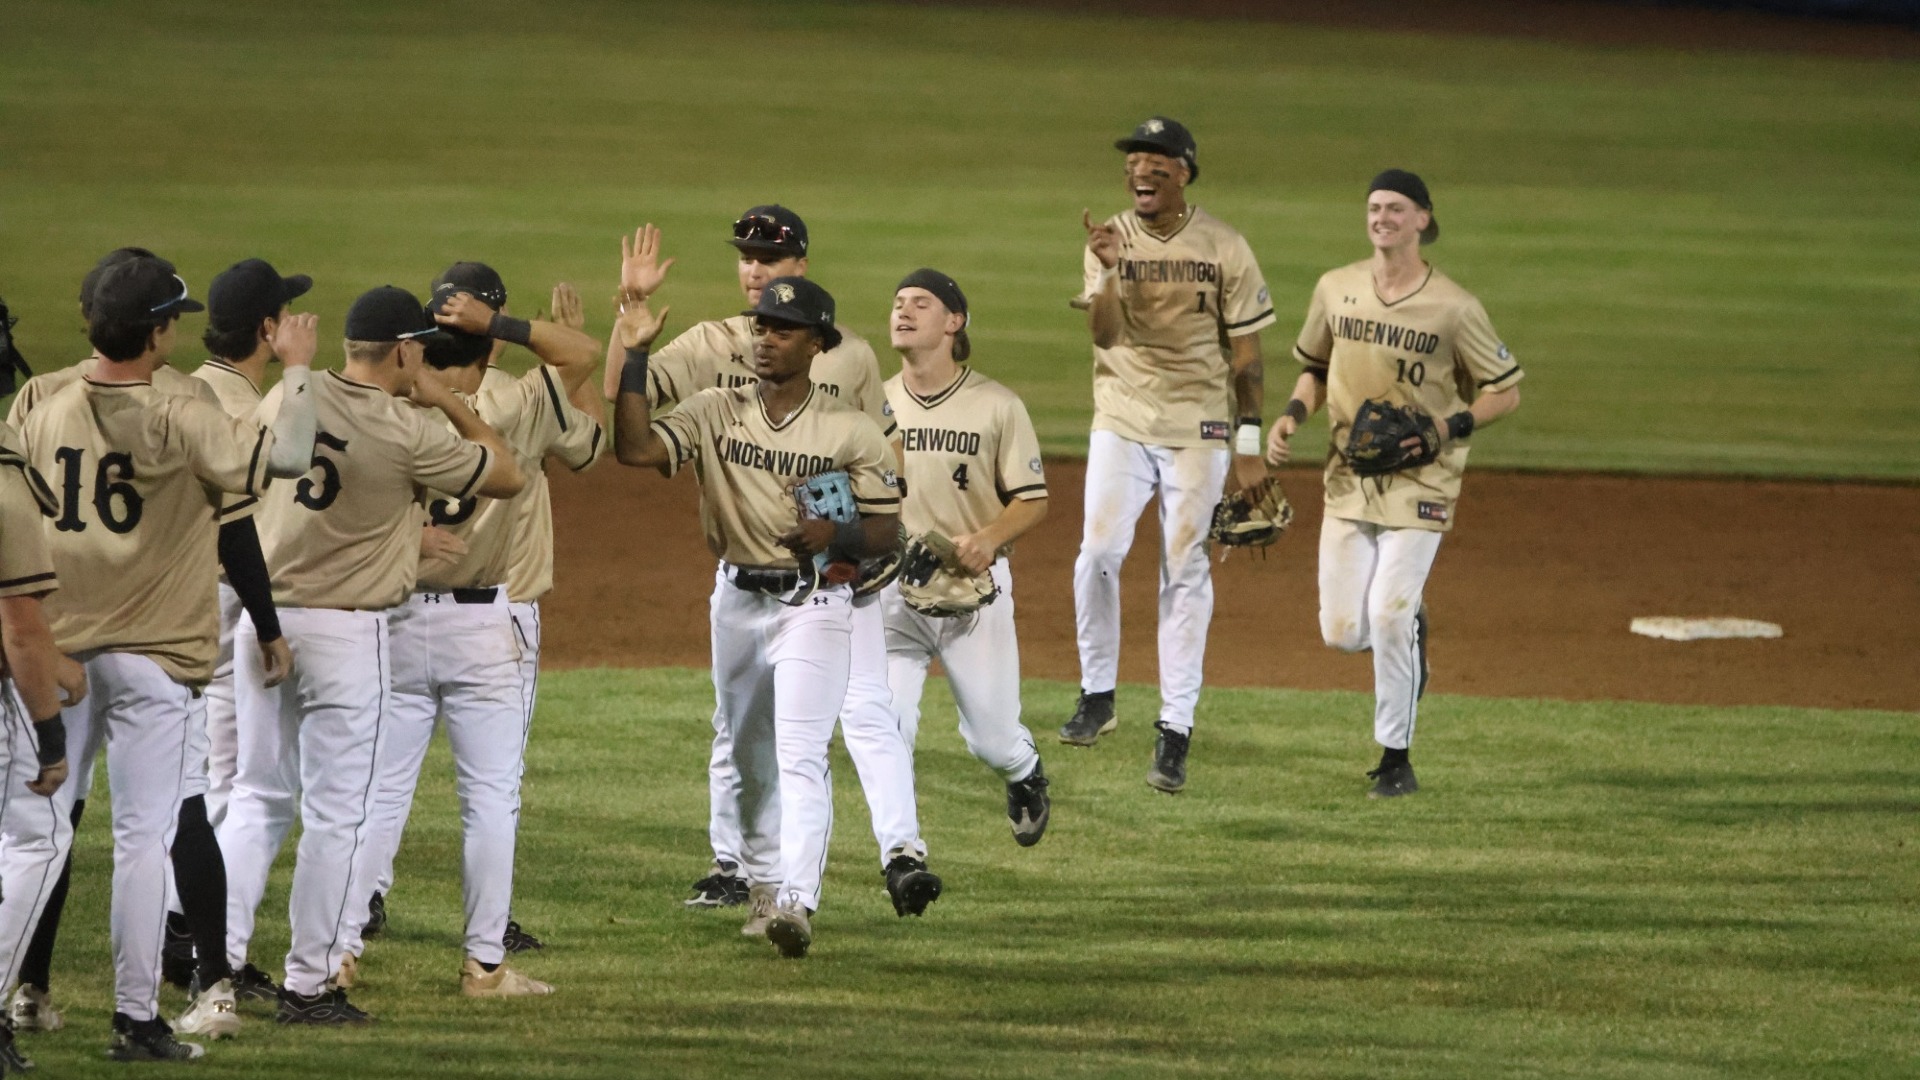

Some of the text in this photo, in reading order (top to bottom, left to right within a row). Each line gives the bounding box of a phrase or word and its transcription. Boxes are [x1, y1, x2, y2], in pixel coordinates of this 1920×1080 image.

[1195, 291, 1207, 314] 1
[1332, 314, 1439, 355] LINDENWOOD
[1396, 358, 1425, 387] 10
[294, 431, 348, 511] 5
[952, 463, 969, 491] 4
[55, 446, 145, 534] 16
